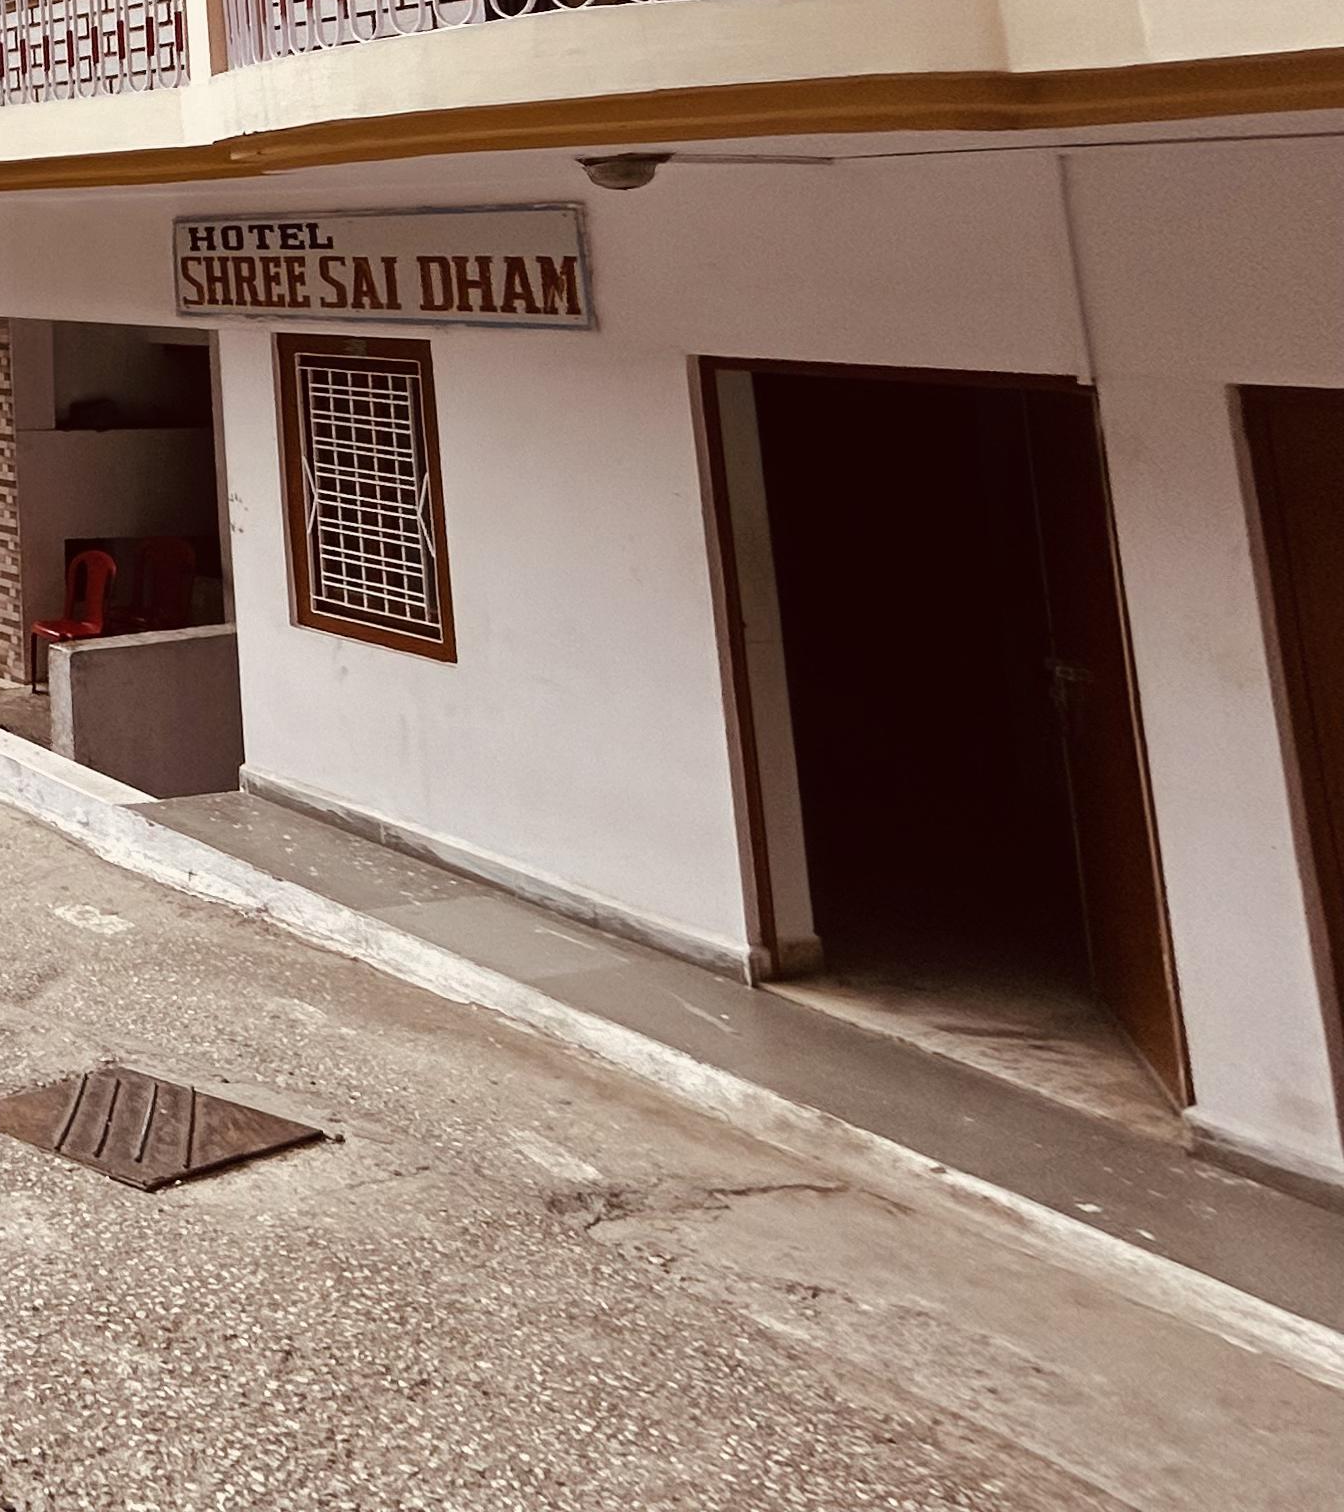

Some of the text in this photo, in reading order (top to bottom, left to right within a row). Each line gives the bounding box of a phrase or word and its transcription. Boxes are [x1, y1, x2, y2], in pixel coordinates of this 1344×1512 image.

[188, 223, 334, 251] HOTEL
[180, 255, 582, 316] SHREE SAI DHAM
